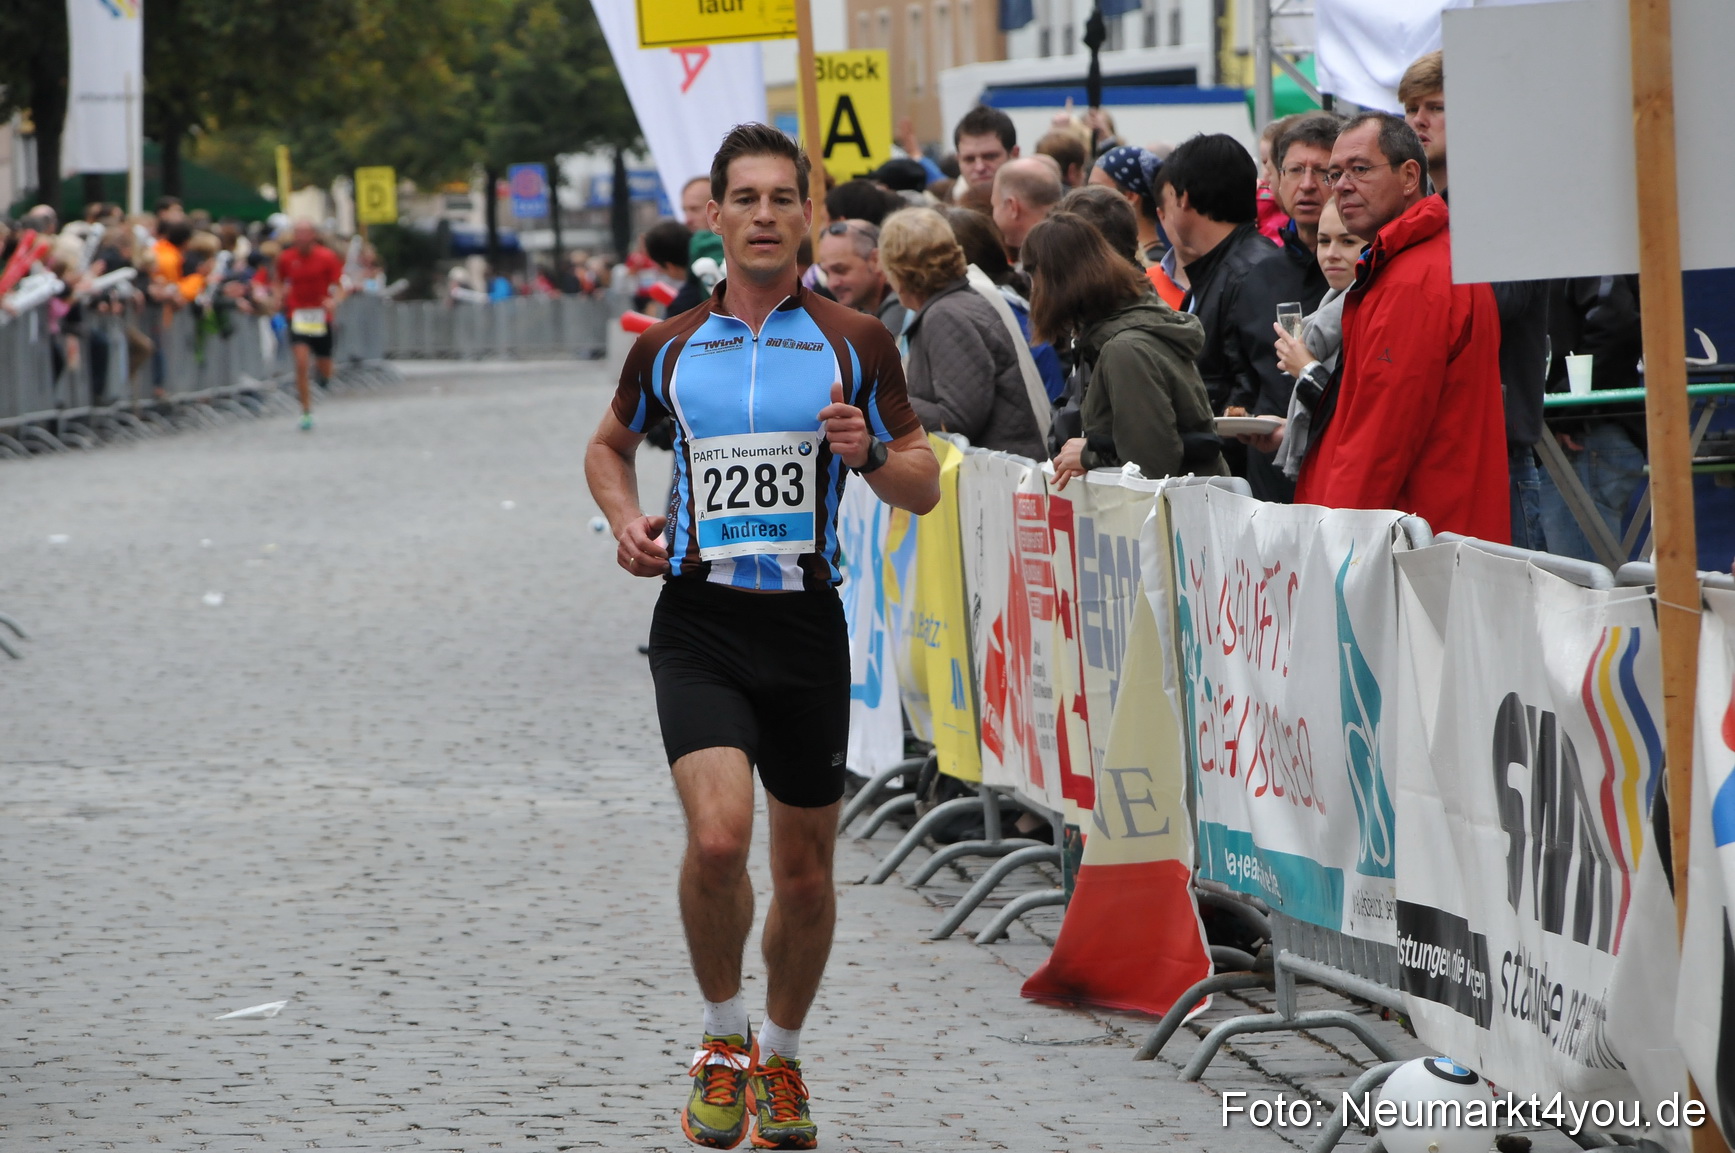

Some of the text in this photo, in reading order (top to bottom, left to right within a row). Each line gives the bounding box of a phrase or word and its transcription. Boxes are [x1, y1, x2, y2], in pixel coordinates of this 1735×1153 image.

[815, 57, 880, 80] Block
[823, 95, 871, 158] A
[693, 445, 793, 463] PARTL Neumarkt
[704, 462, 804, 512] 2283
[721, 521, 787, 541] Andreas
